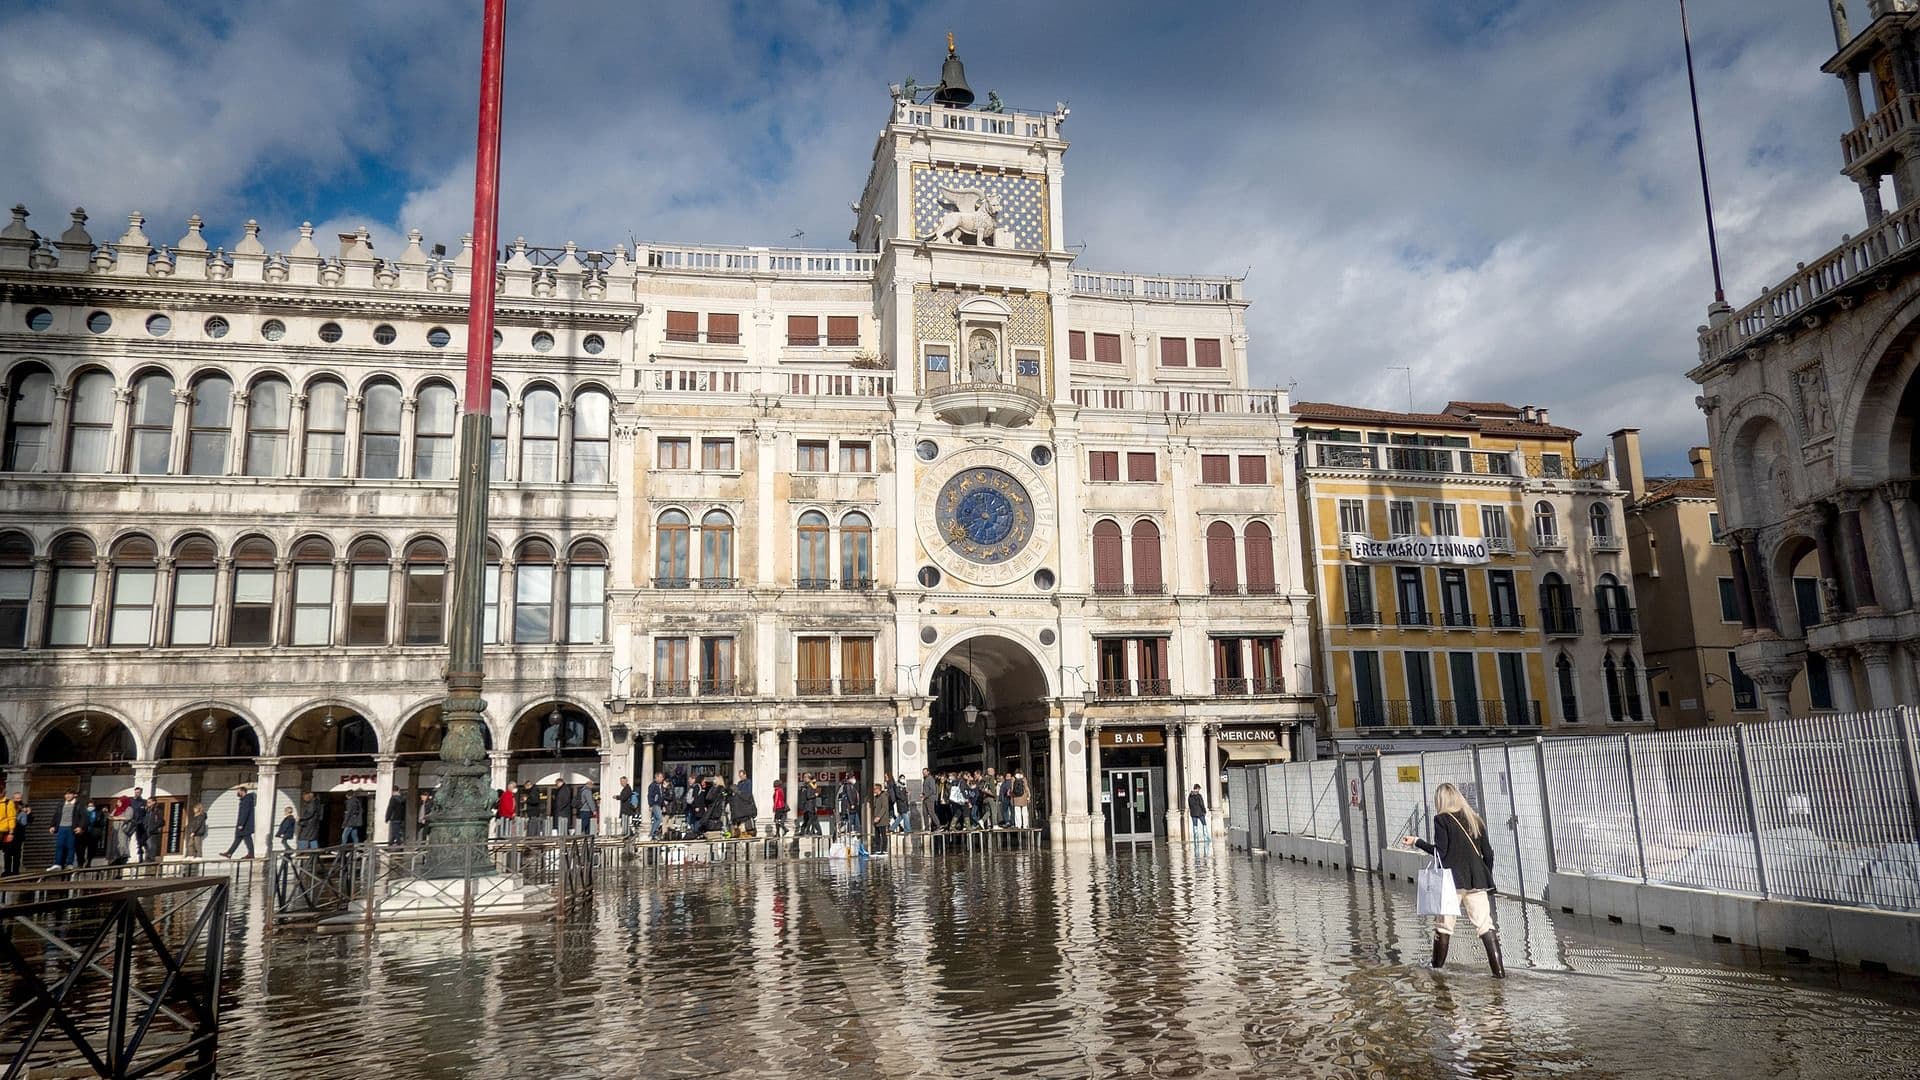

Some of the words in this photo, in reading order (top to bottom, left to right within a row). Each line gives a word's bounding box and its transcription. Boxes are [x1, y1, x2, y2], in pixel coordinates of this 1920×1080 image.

[928, 355, 946, 371] IX
[1355, 542, 1383, 557] FREE
[1386, 542, 1428, 557] MARCO
[1429, 543, 1485, 558] ZENNARO
[1114, 733, 1145, 743] BAR
[1216, 730, 1276, 741] AMERICANO
[800, 745, 844, 756] CHANGE
